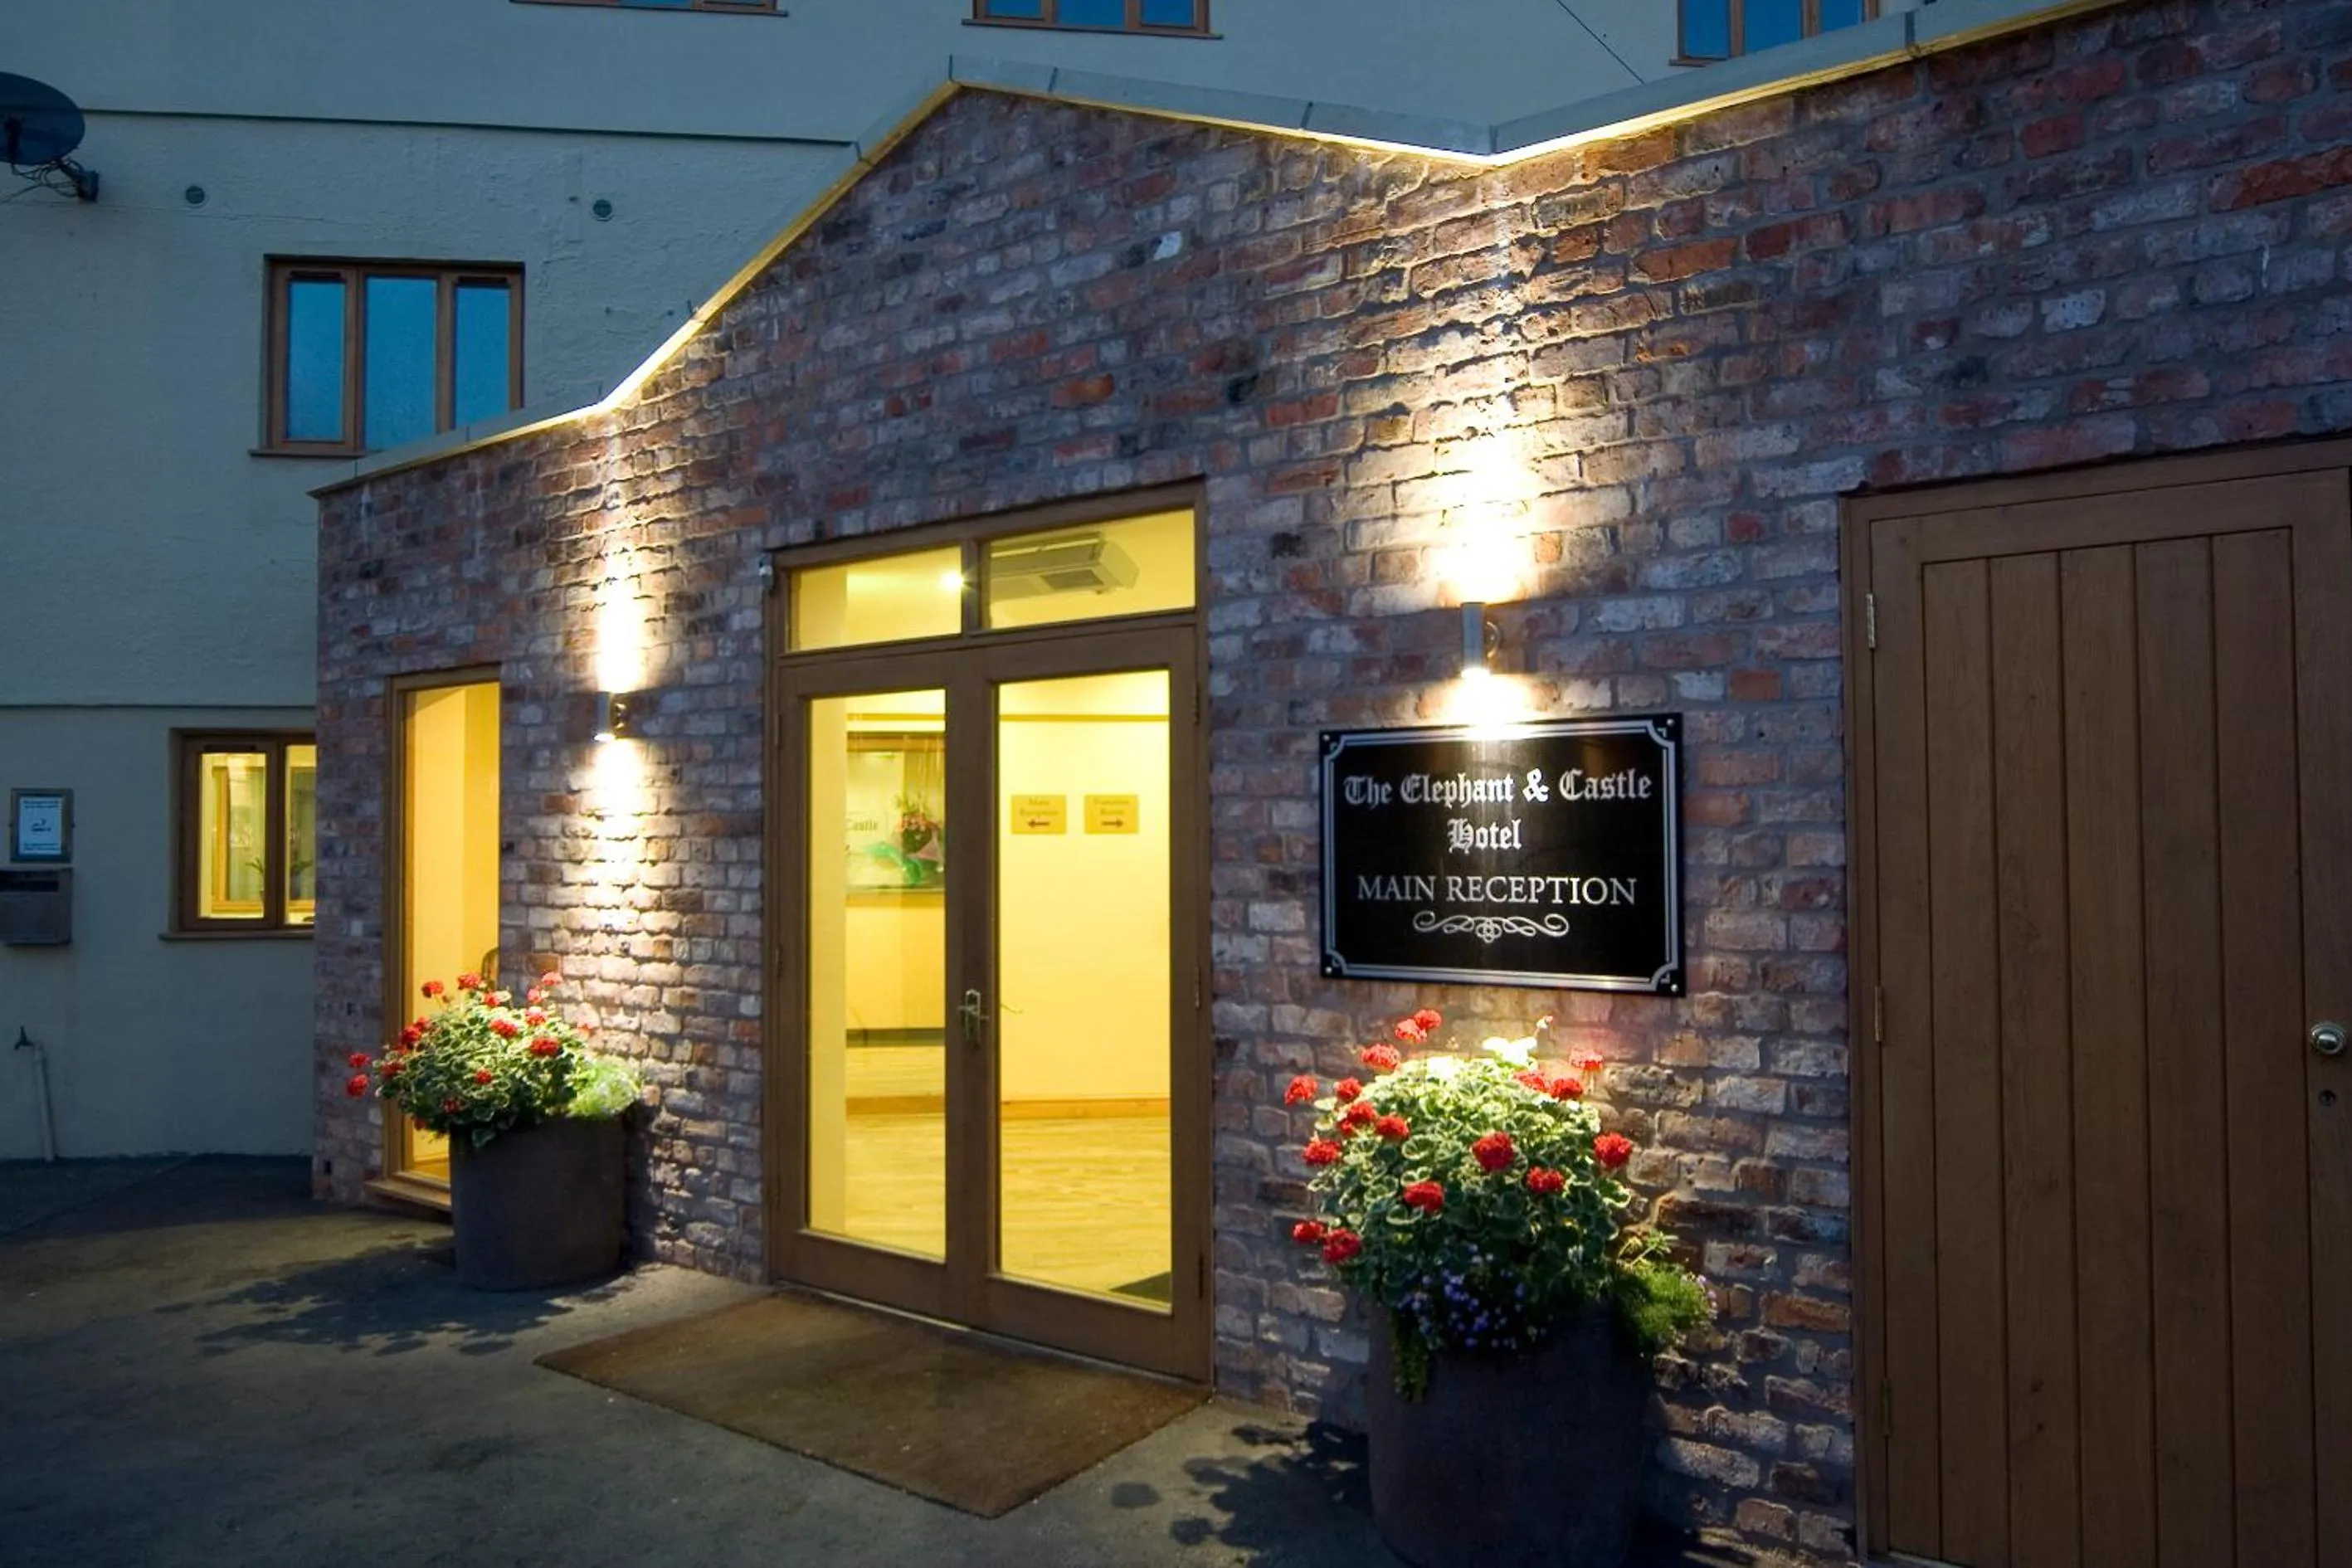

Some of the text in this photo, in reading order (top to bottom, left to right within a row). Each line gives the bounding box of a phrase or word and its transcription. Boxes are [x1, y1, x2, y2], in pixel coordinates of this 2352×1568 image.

[1343, 767, 1653, 810] The Elephant & Castle
[1446, 817, 1523, 855] Hotel
[1356, 874, 1638, 906] MAIN RECEPTION
